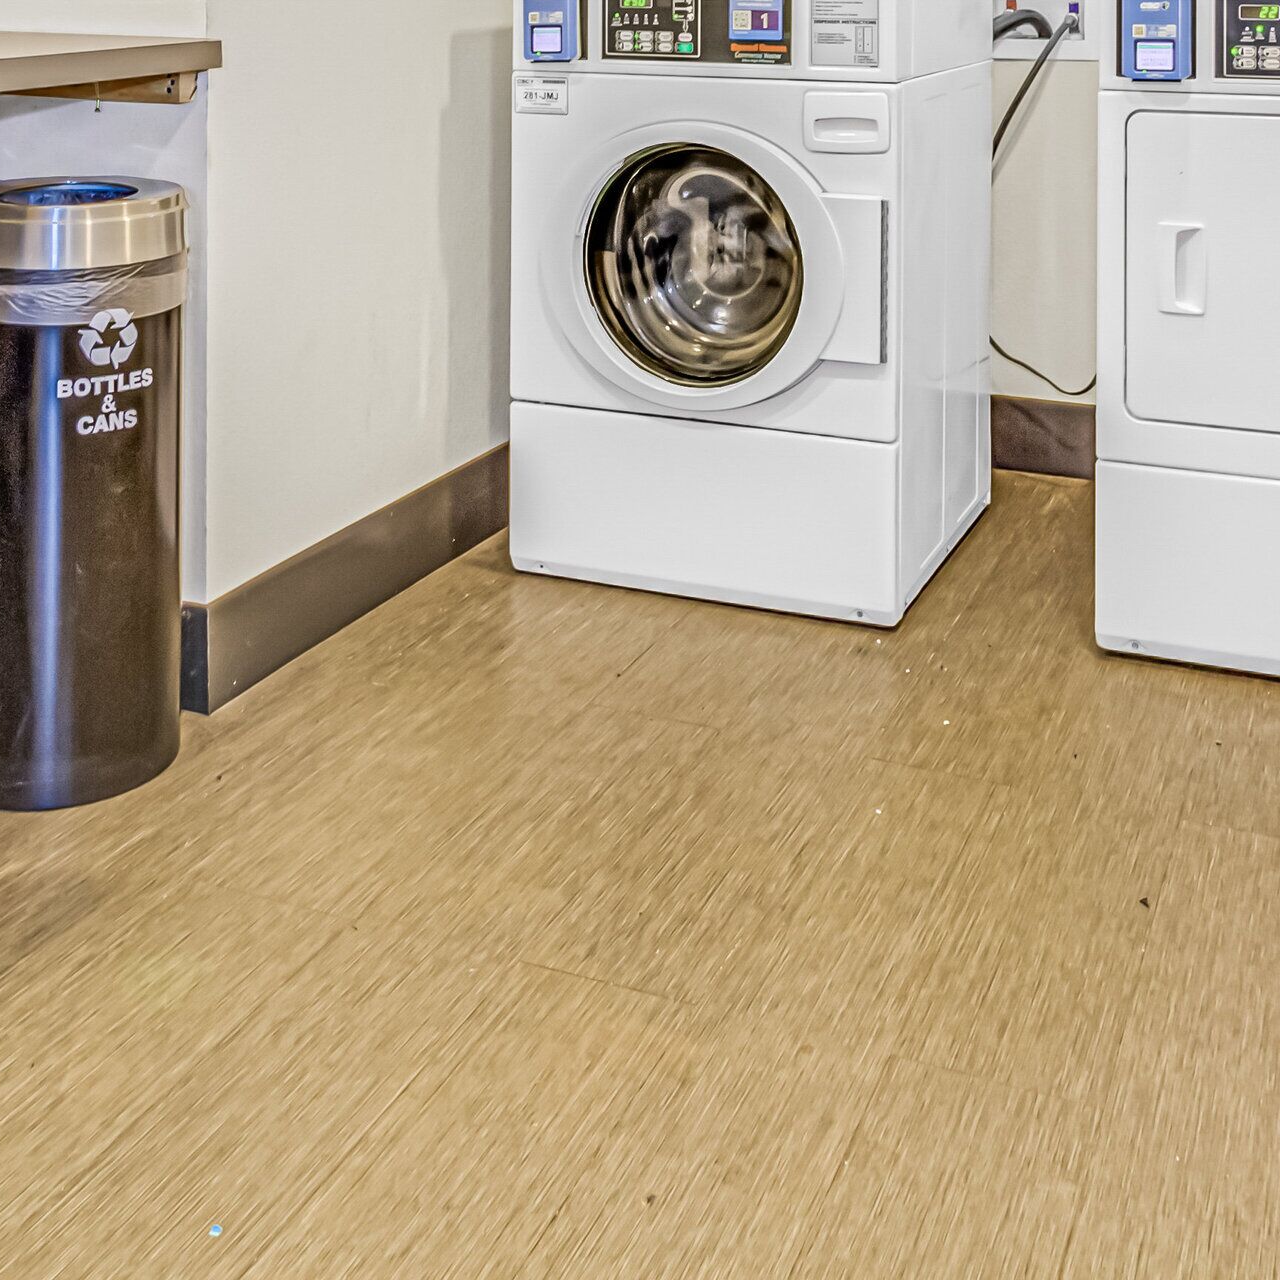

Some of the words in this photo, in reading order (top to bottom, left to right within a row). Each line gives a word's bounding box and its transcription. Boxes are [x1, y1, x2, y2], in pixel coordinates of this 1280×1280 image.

[760, 12, 768, 29] 1
[1259, 6, 1278, 18] 22
[57, 368, 153, 398] BOTTLES
[101, 394, 116, 413] &
[76, 410, 138, 435] CANS
